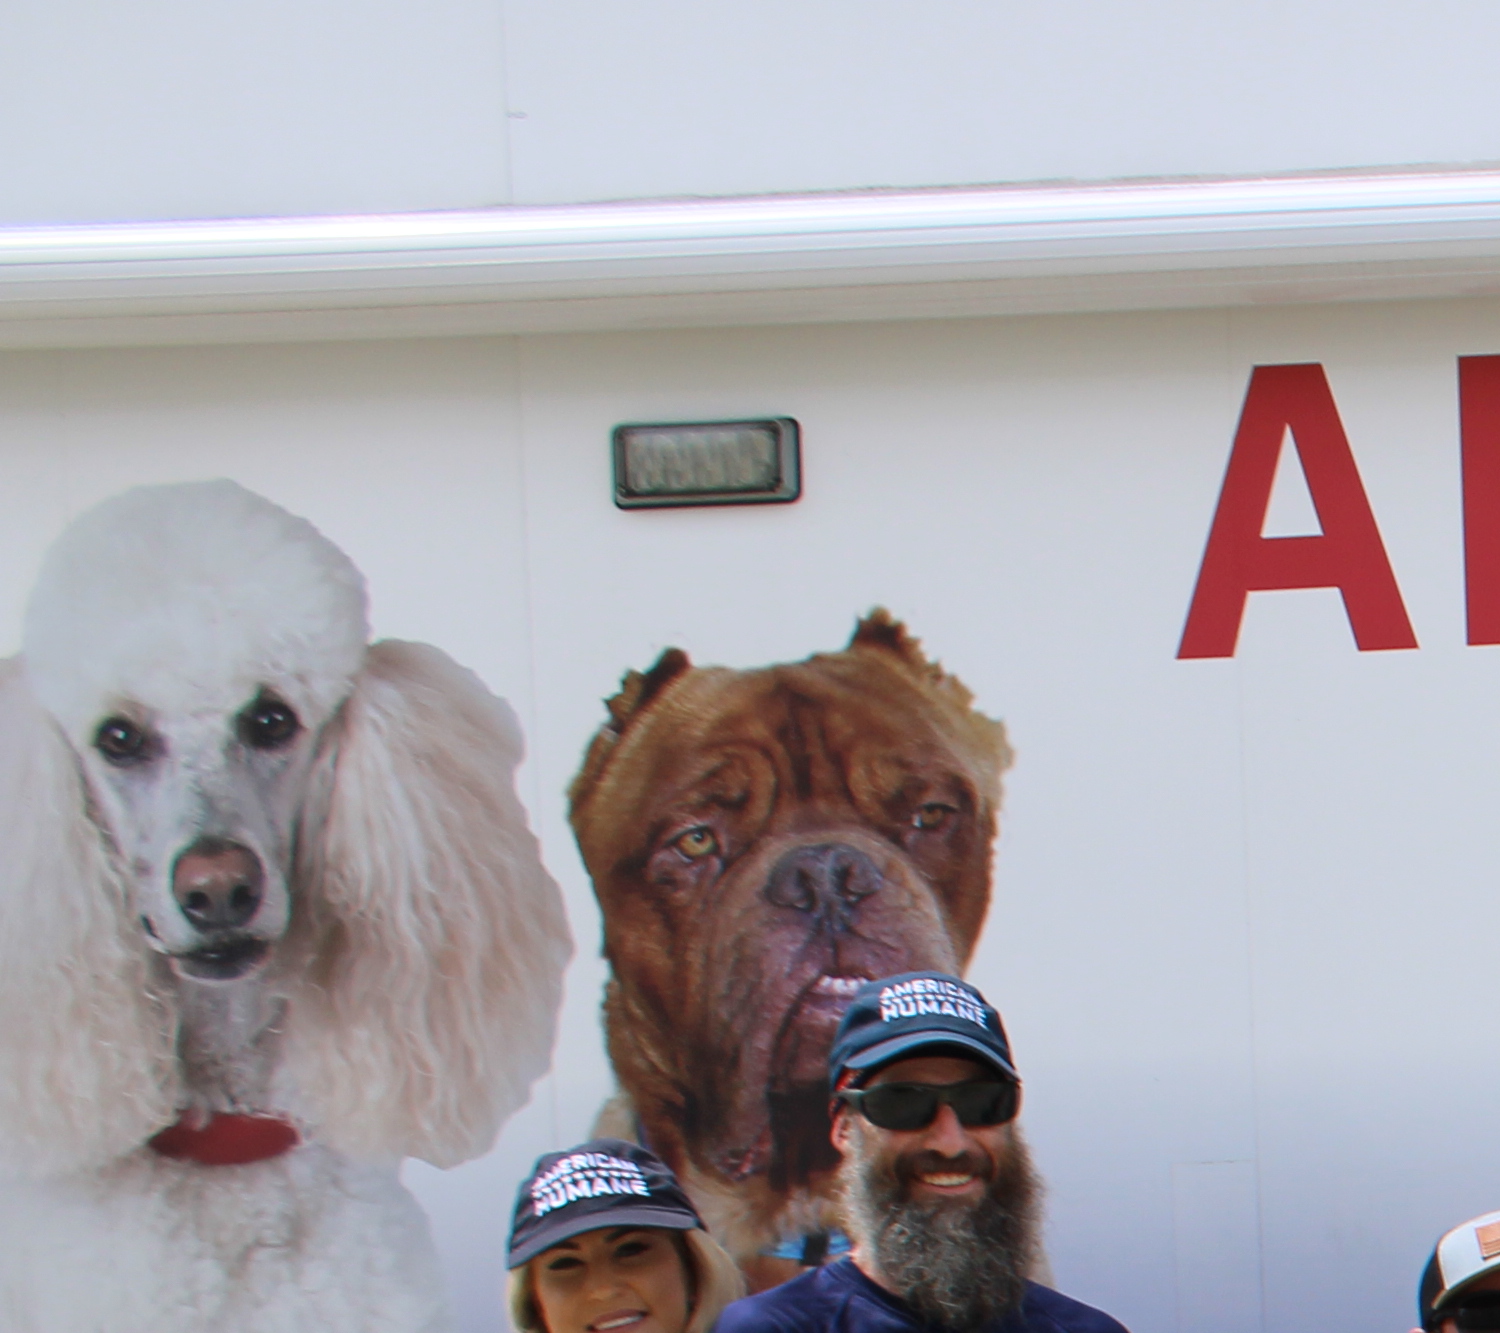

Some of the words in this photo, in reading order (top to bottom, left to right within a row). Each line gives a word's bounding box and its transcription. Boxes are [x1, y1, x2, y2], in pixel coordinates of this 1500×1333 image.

[879, 978, 982, 1007] AMERICAN
[881, 998, 989, 1032] HUMANE
[531, 1152, 641, 1190] AMERICAN
[533, 1176, 652, 1217] HUMANE
